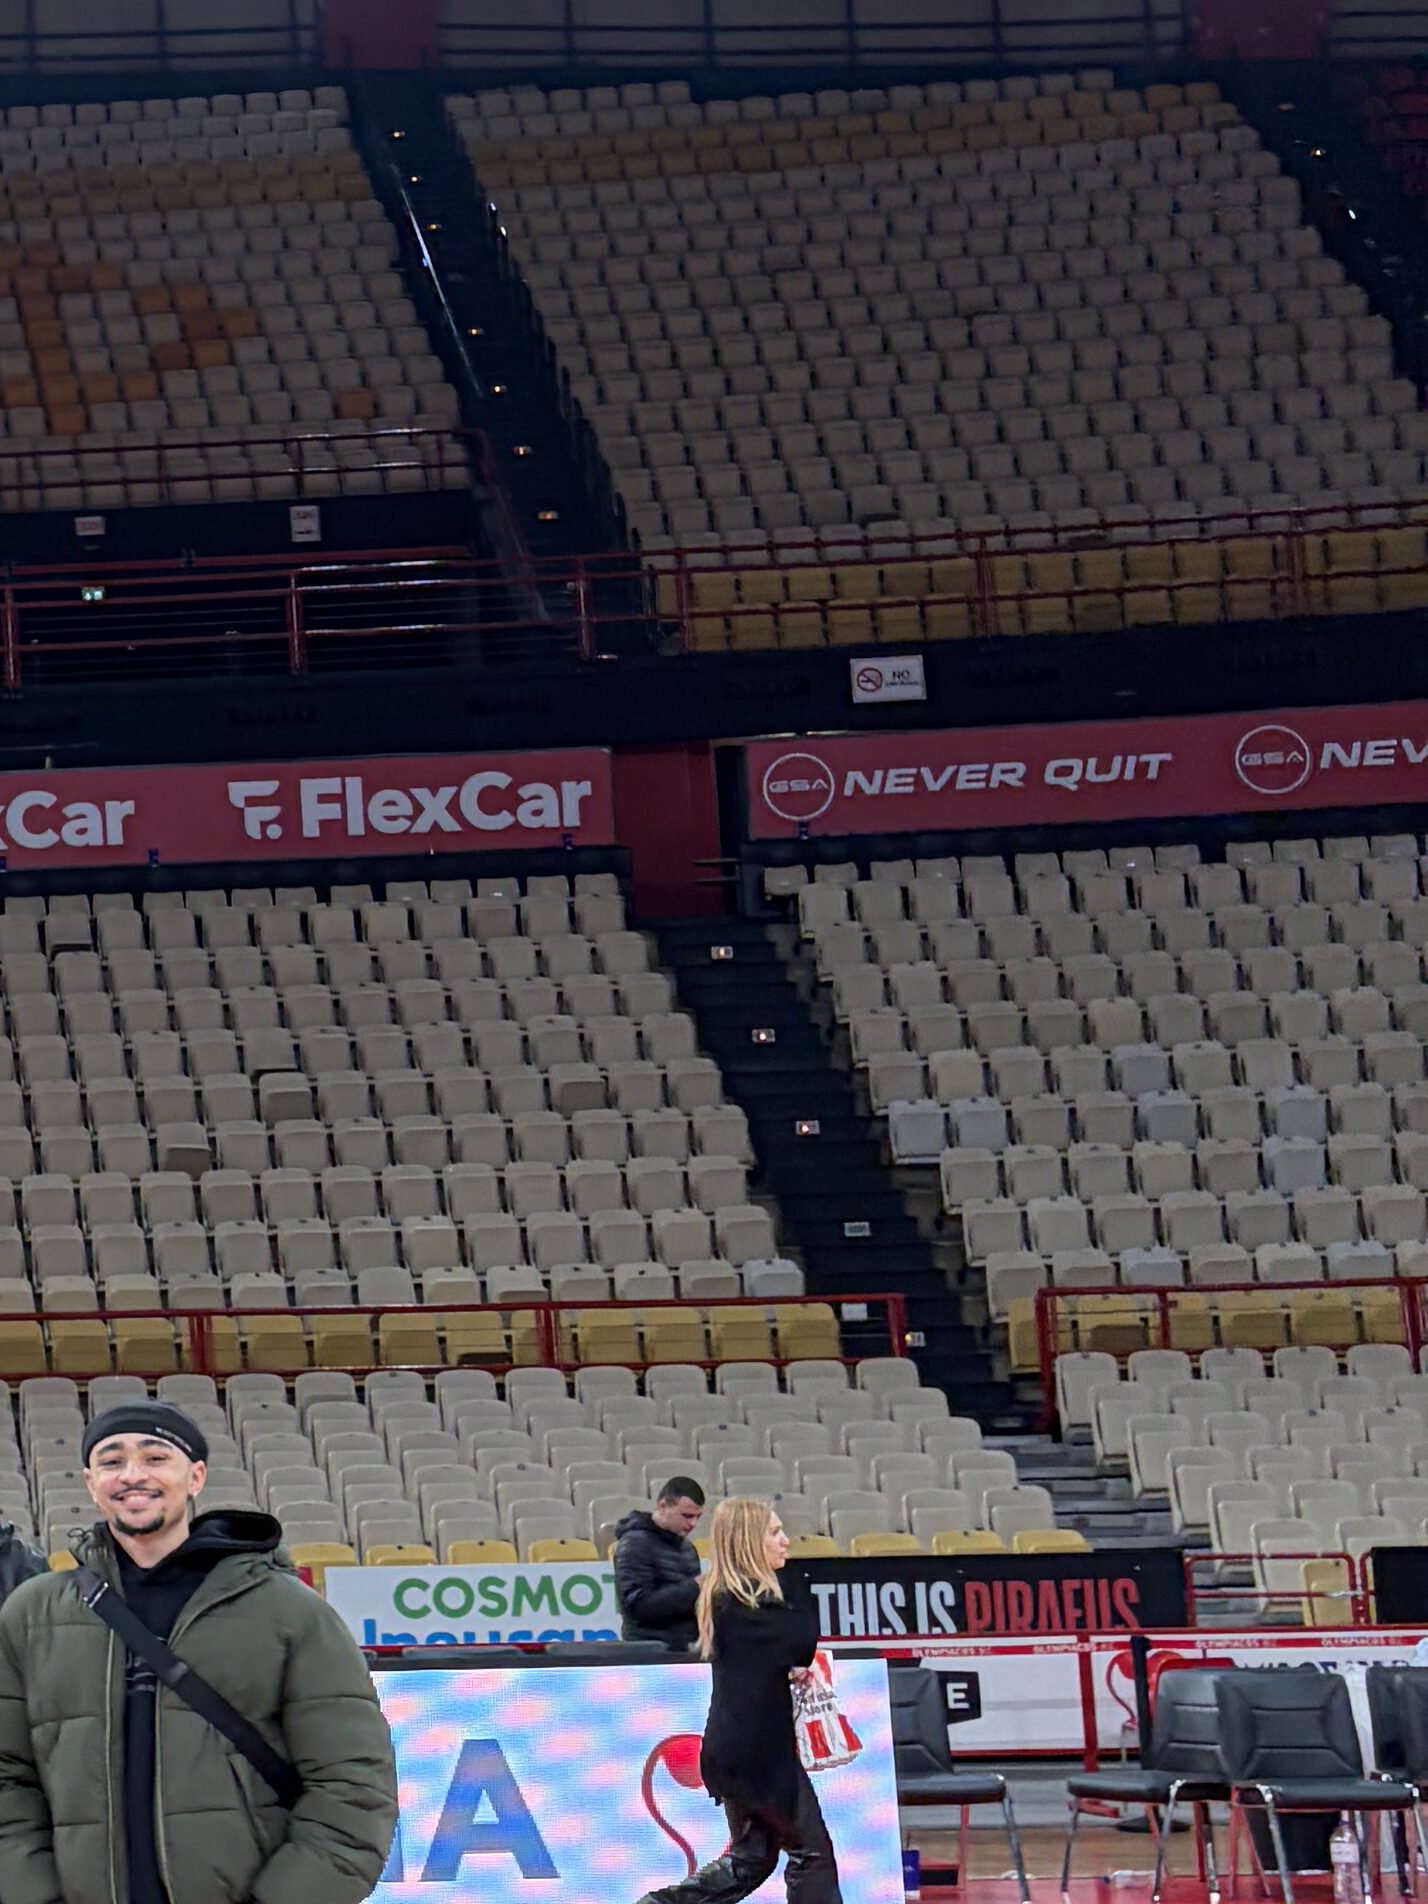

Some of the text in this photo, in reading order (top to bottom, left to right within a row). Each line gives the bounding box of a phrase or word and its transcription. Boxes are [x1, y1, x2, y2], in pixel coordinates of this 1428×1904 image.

[844, 753, 1173, 796] NEVER QUIT
[301, 770, 591, 838] FlexCar
[394, 1574, 619, 1619] COSMO
[810, 1578, 1140, 1636] THIS IS PIRAEUS
